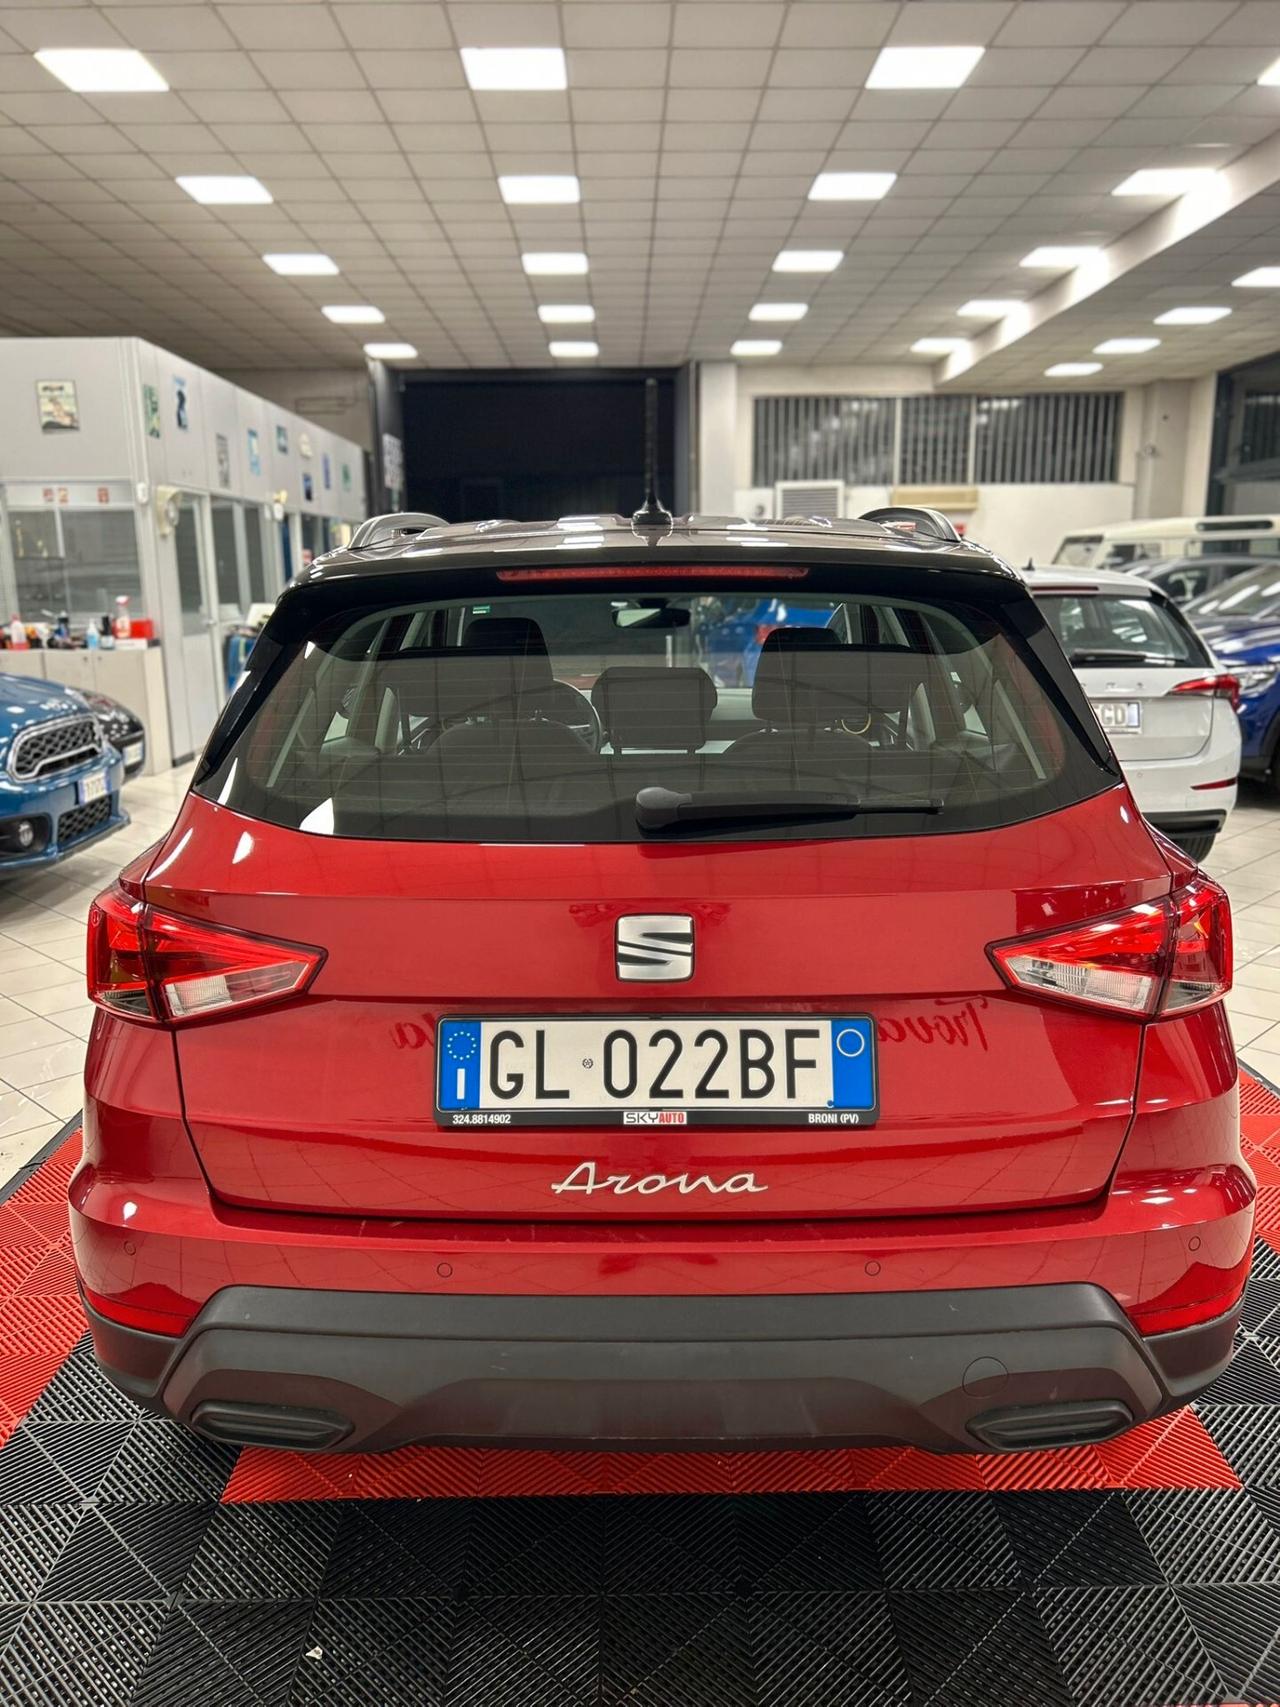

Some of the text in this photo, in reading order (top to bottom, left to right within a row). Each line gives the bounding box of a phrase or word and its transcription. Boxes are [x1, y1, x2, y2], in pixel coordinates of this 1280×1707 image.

[490, 1029, 820, 1100] GL 022BF
[452, 1114, 511, 1125] 324.8814902
[808, 1113, 859, 1124] BRONI (PV)
[551, 1162, 769, 1195] Arona
